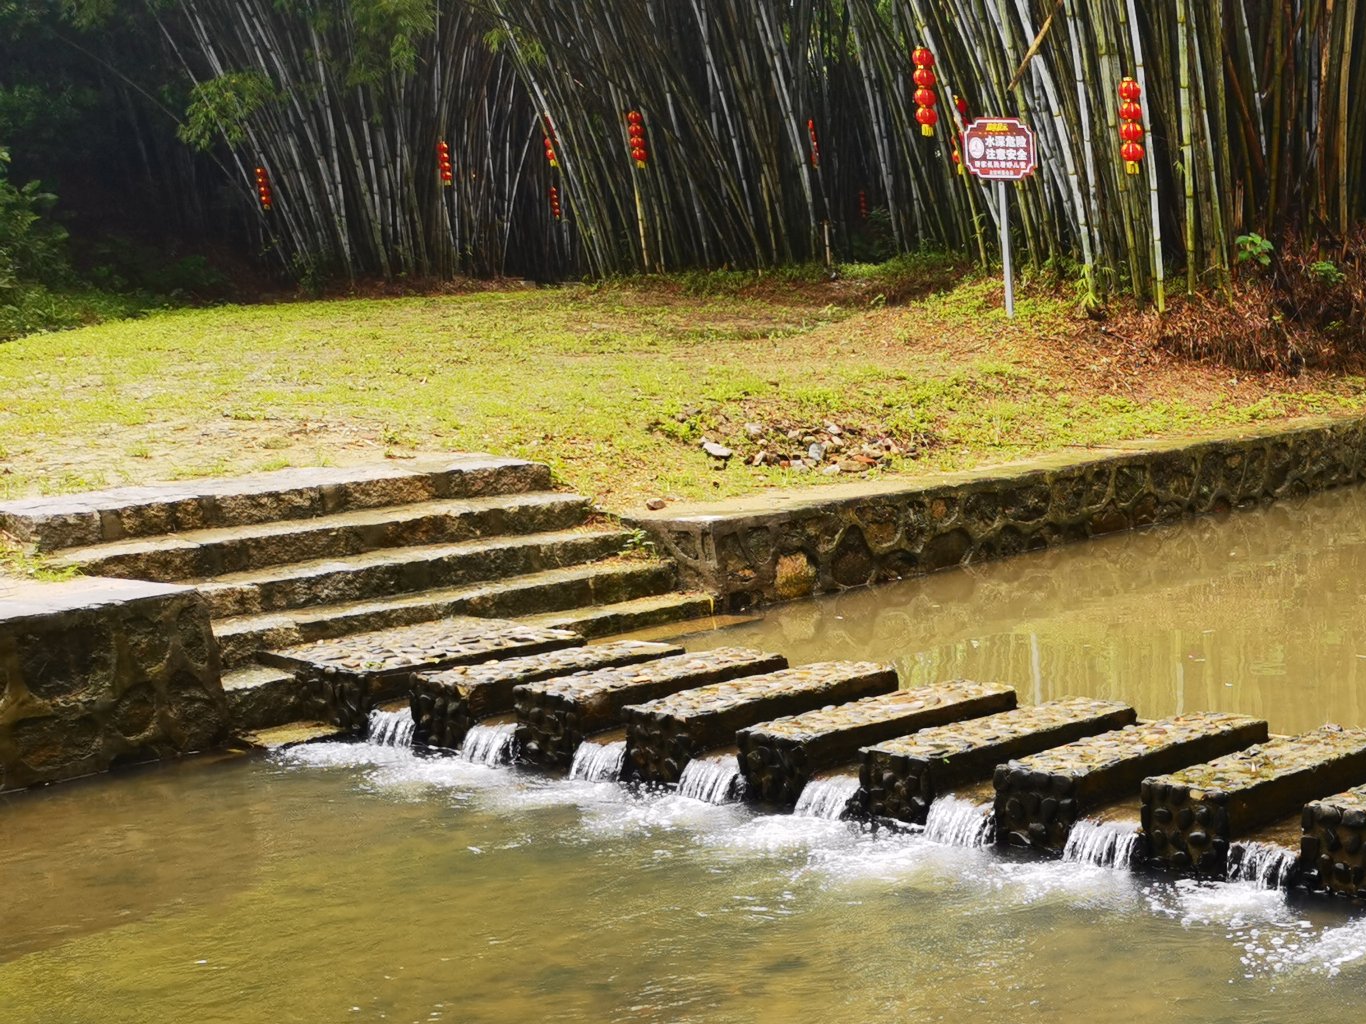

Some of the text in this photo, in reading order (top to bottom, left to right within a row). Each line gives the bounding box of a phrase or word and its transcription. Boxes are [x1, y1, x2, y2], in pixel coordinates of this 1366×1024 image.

[985, 136, 1027, 147] 水深危险
[986, 149, 1027, 160] 注意安全
